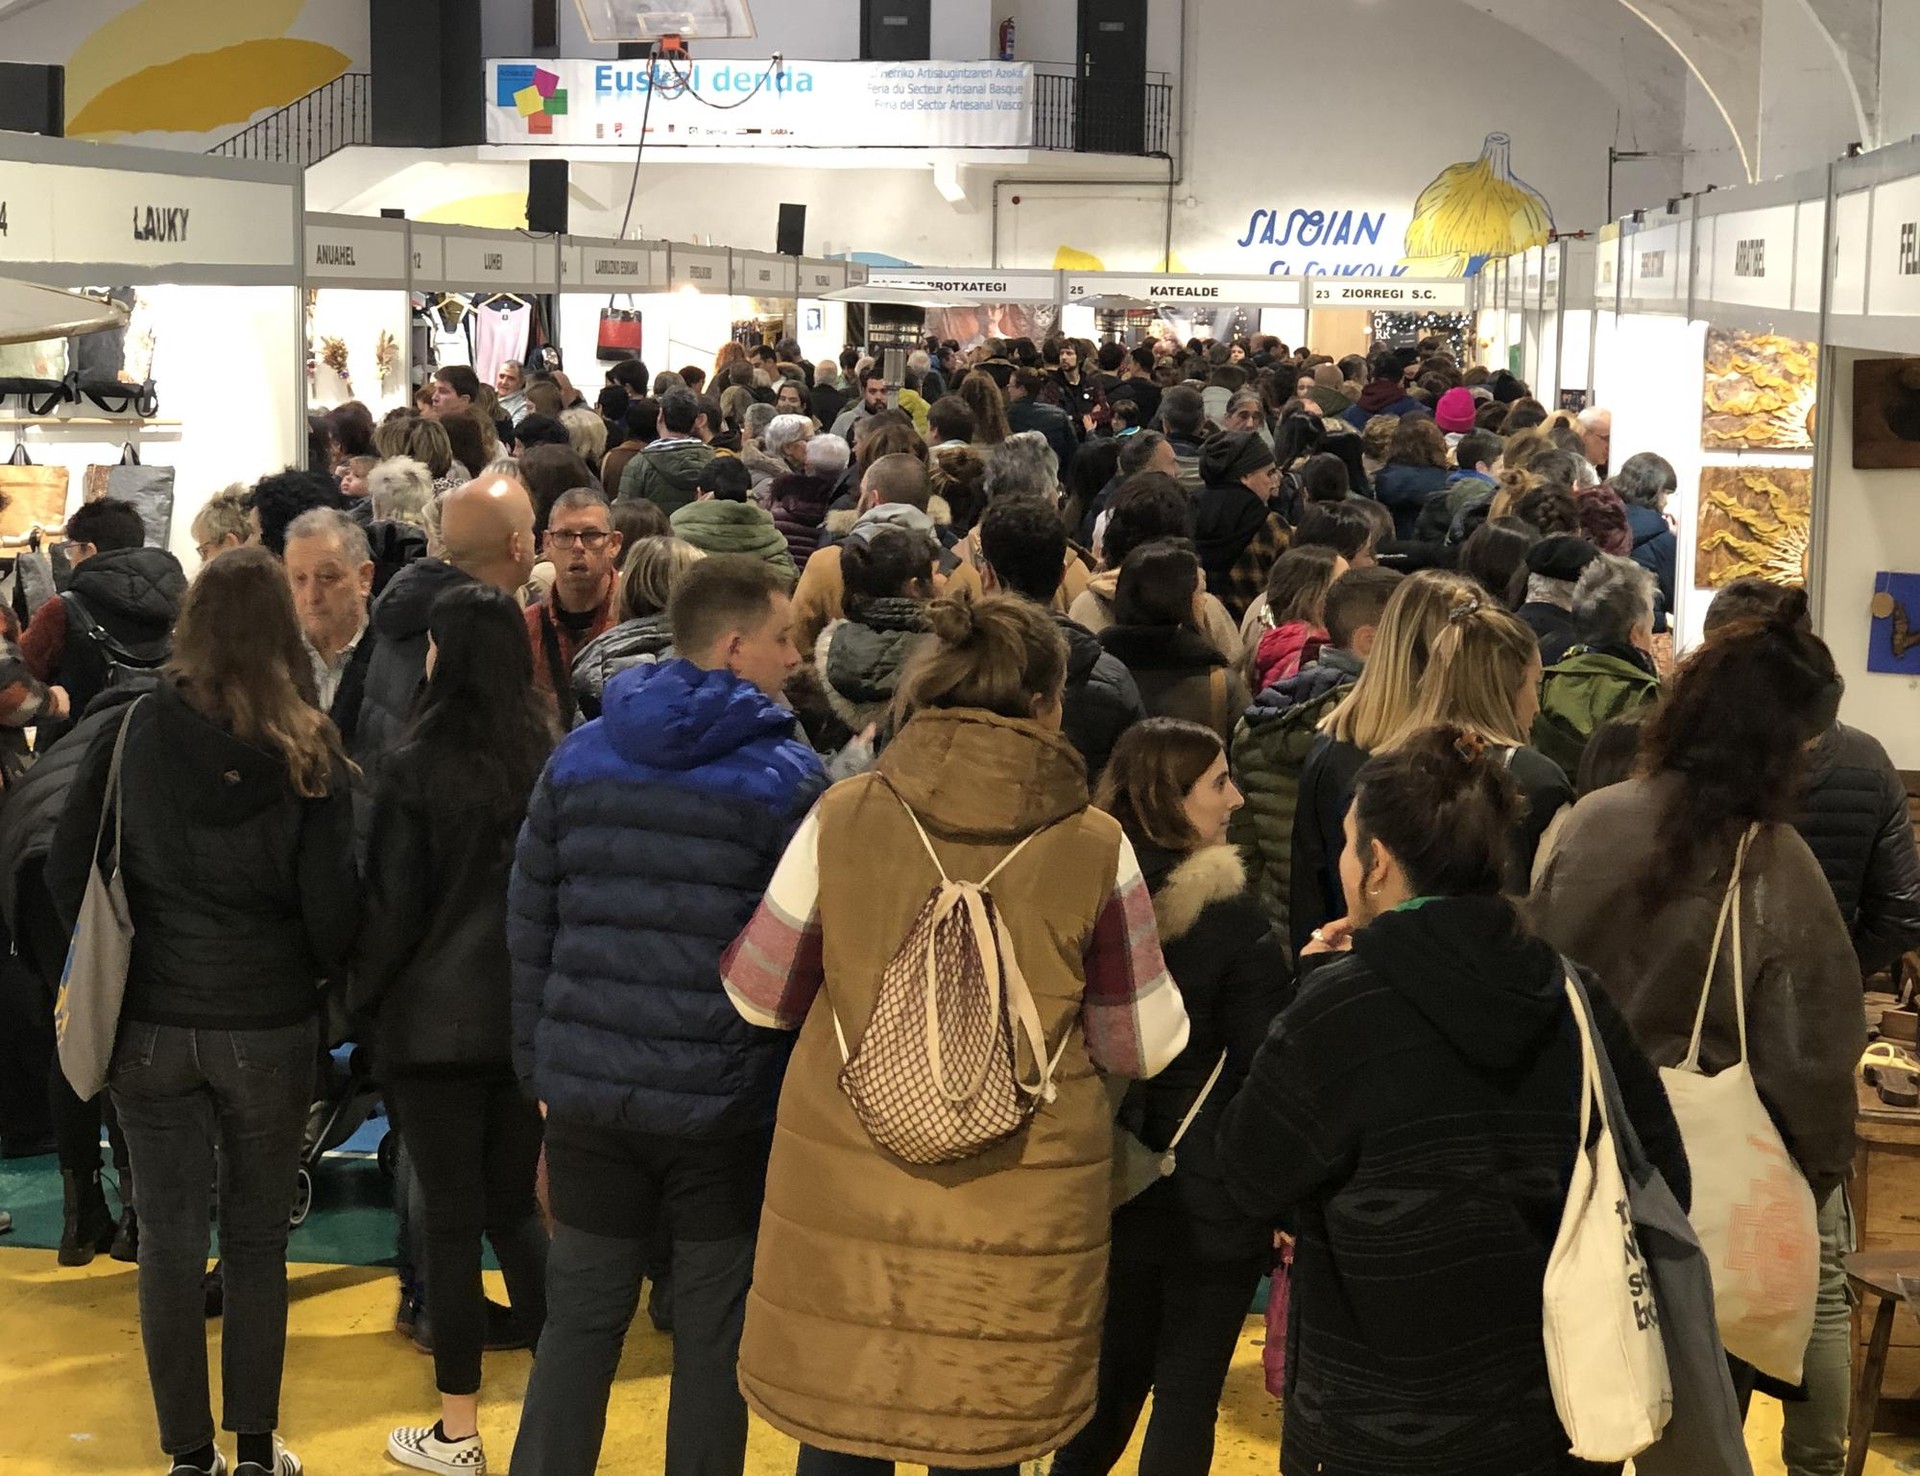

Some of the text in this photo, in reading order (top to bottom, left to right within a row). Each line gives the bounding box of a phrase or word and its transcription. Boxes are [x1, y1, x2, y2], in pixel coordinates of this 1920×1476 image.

[713, 63, 813, 92] denda
[917, 67, 993, 81] Artisaugintzaren
[995, 67, 1024, 79] Azoka
[892, 83, 905, 95] du
[907, 83, 943, 95] Secteur
[945, 83, 986, 95] Artisanal
[989, 83, 1024, 97] Basque
[900, 99, 915, 110] del
[917, 99, 947, 110] Sector
[949, 99, 993, 110] Artesanal
[995, 99, 1024, 110] Vasco
[133, 205, 190, 242] LAUKY
[316, 244, 356, 266] ANUAHEL
[1898, 222, 1920, 275] FEL
[1069, 285, 1219, 297] 25 KATEALDE
[1315, 288, 1437, 300] 23 ZIORREGI S.C.
